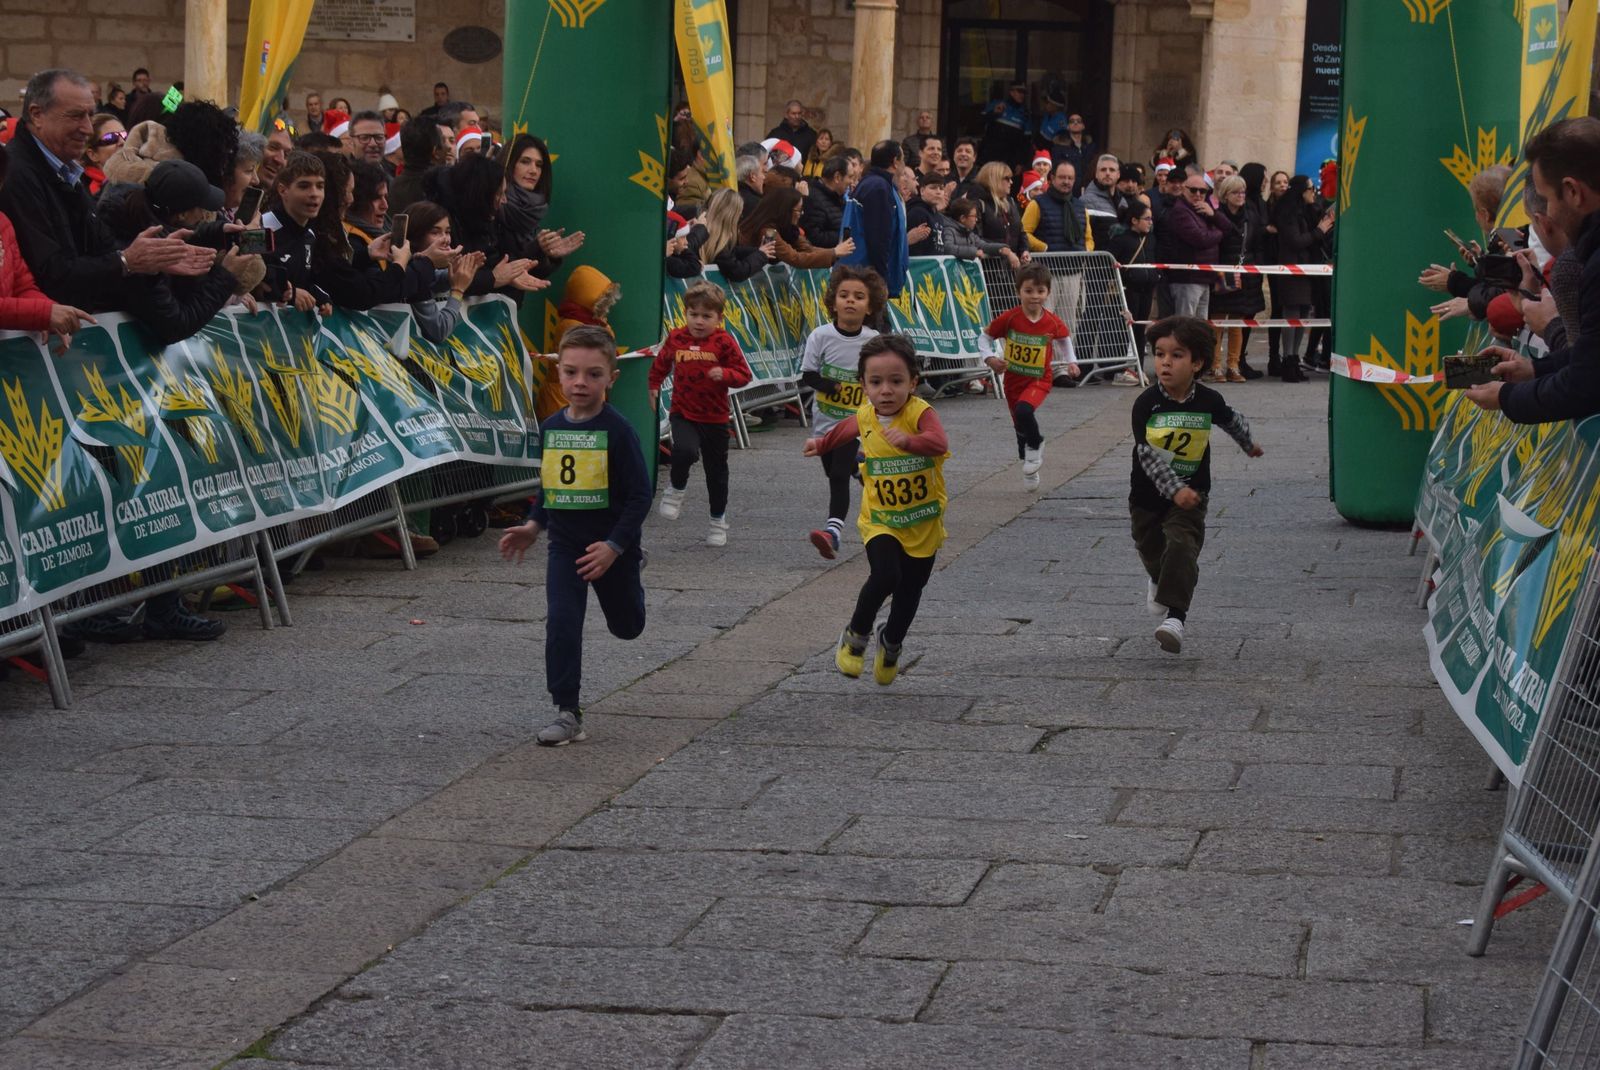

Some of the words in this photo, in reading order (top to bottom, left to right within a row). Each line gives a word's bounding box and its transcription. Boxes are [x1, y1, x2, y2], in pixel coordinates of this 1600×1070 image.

[1312, 43, 1338, 52] Desde
[1313, 55, 1324, 63] de
[1009, 342, 1041, 364] 1337
[1163, 432, 1192, 456] 12
[320, 446, 350, 472] AJA
[348, 452, 384, 476] ZAMORA
[560, 454, 576, 485] 8
[193, 476, 218, 500] CAJA
[215, 470, 244, 496] RURAL
[874, 474, 928, 506] 1333
[116, 496, 148, 525] CAJA
[145, 486, 186, 514] RURAL
[208, 500, 220, 514] DE
[572, 494, 604, 504] RURAL
[910, 506, 938, 520] RURAL
[20, 526, 58, 556] CAJA
[56, 510, 104, 544] RURAL
[134, 524, 148, 540] DE
[150, 513, 181, 534] ZAMORA
[41, 554, 56, 572] DE
[58, 542, 94, 566] ZAMORA
